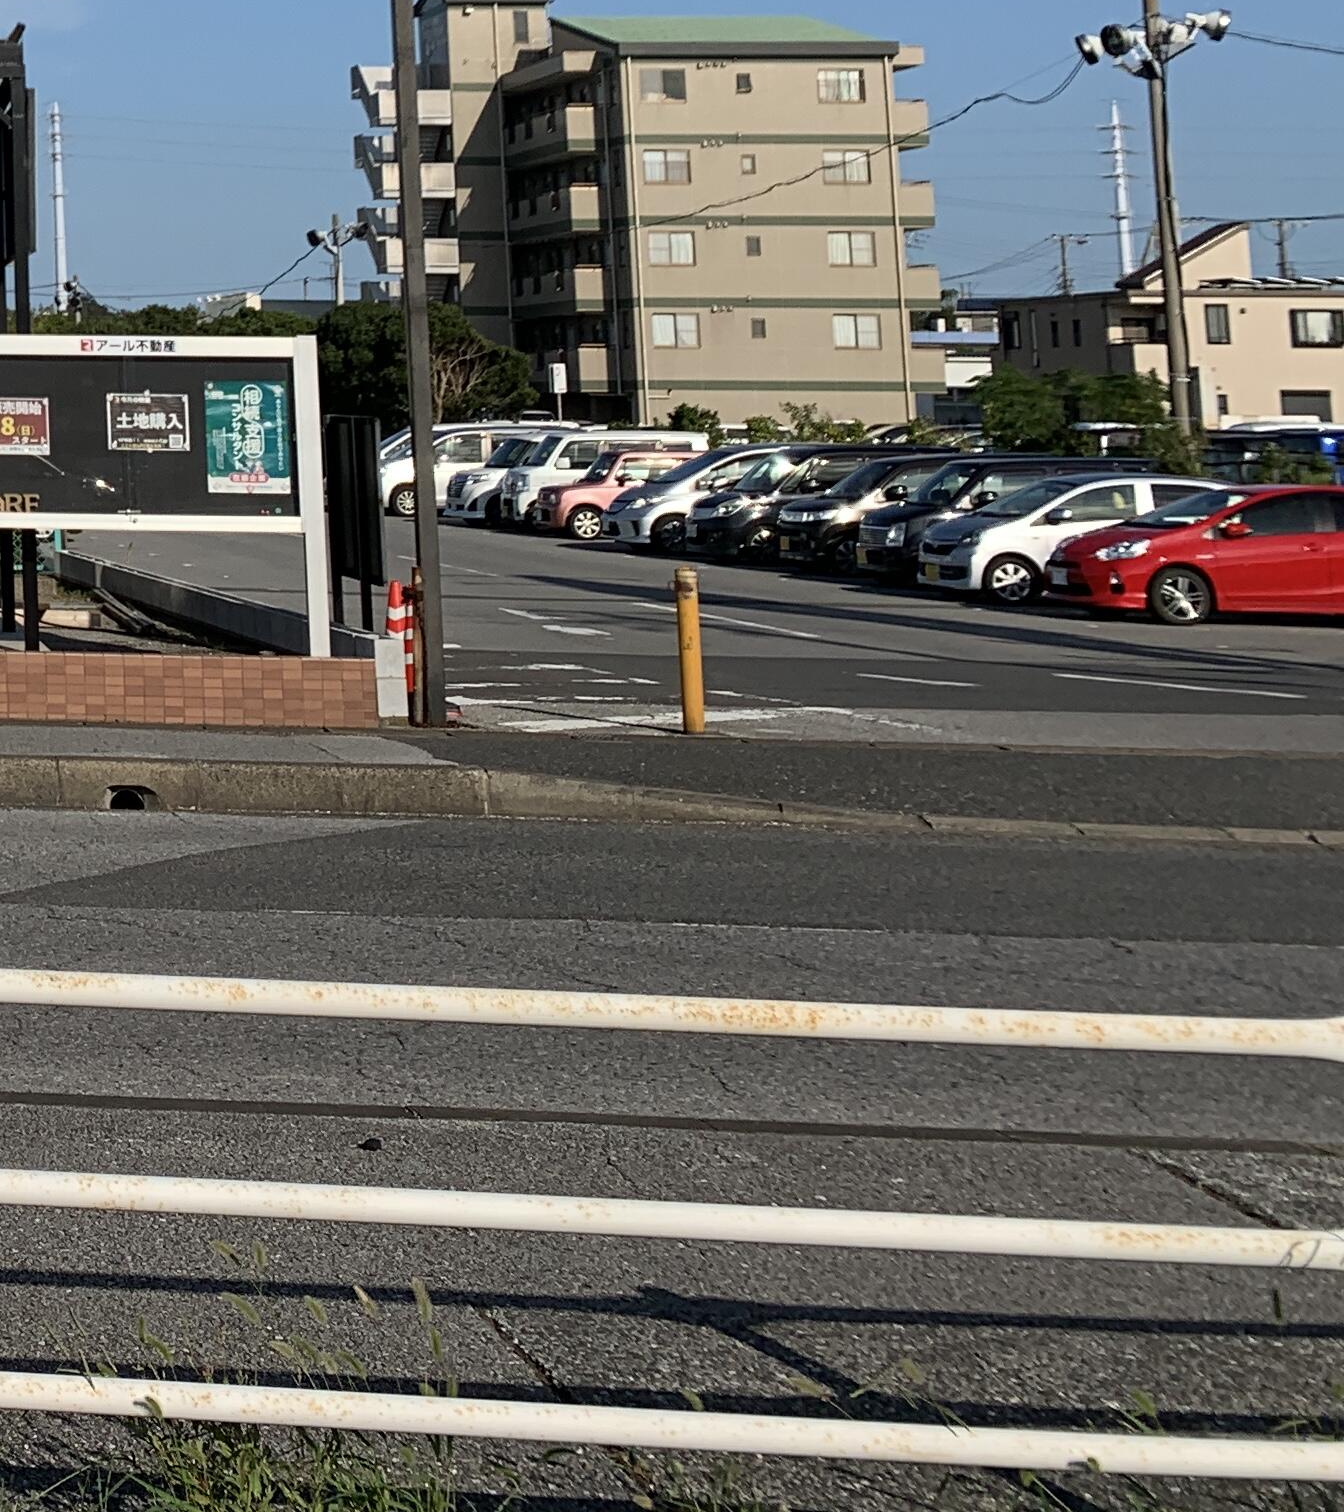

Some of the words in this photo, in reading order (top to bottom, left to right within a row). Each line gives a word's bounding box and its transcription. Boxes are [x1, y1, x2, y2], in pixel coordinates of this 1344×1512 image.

[95, 339, 178, 353] アール不動産
[115, 411, 184, 430] 土地購入
